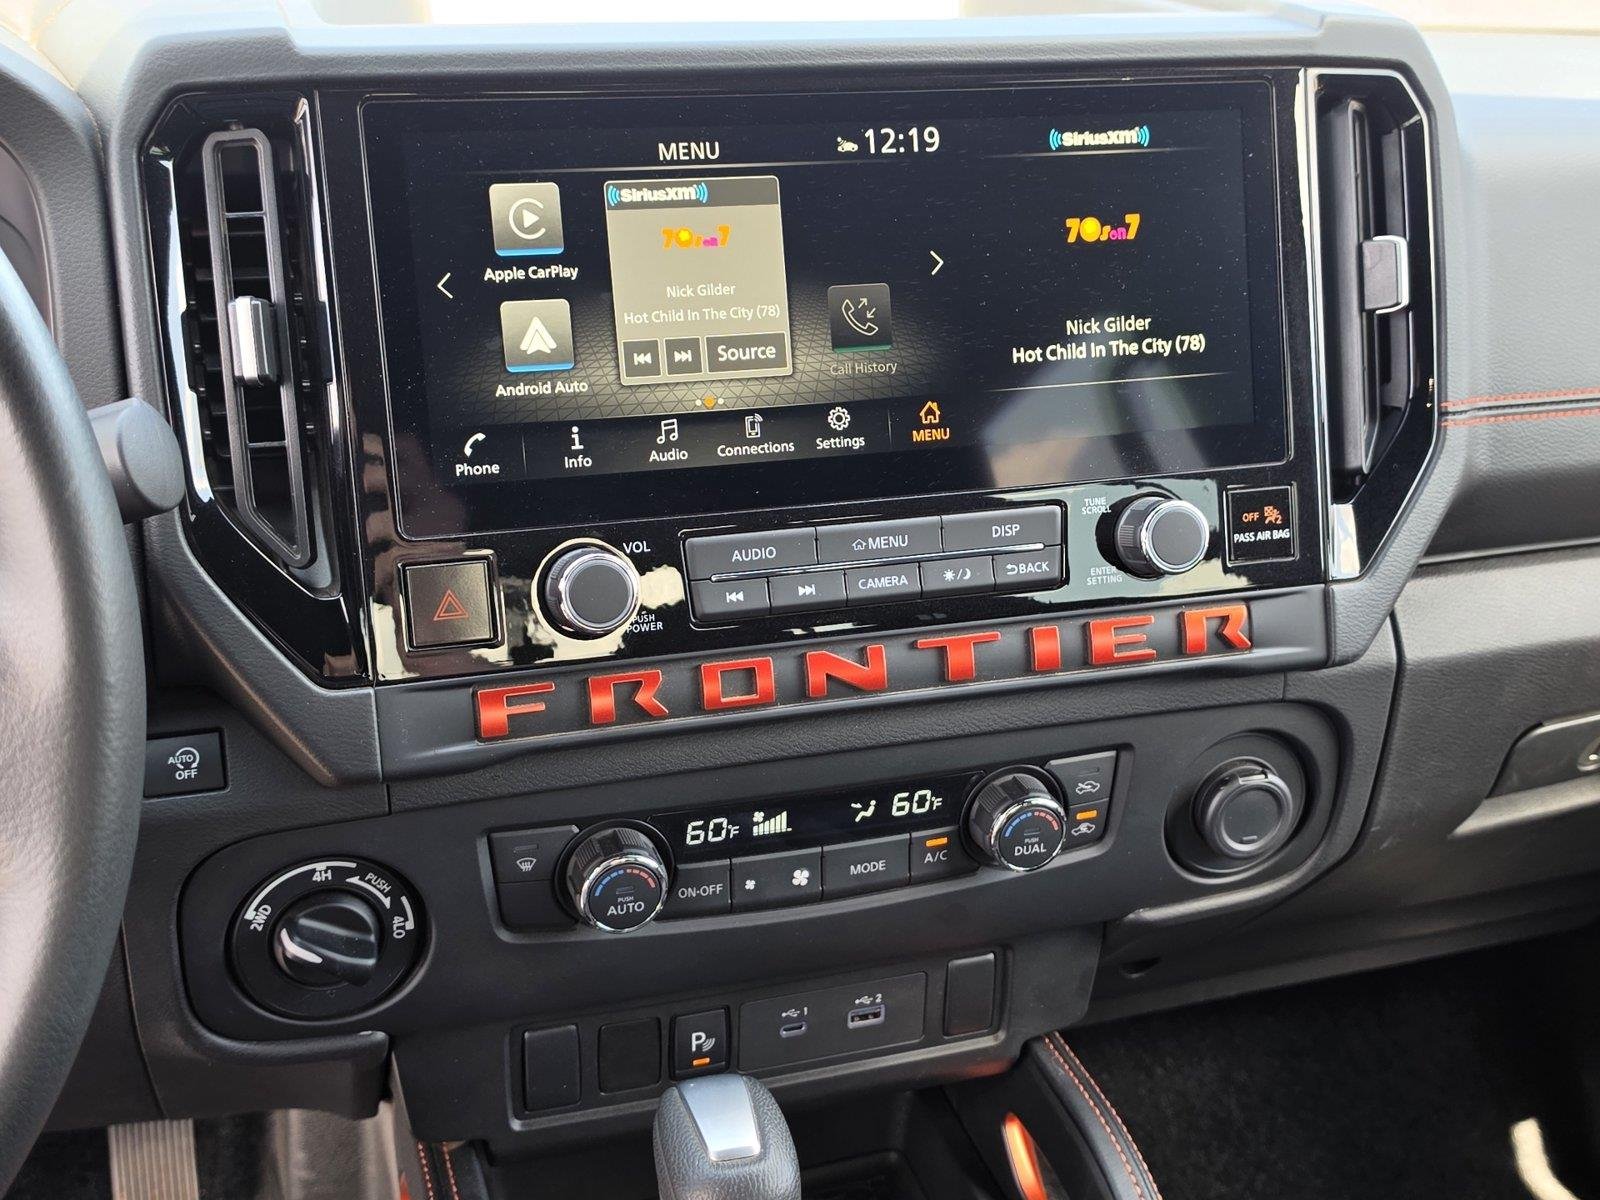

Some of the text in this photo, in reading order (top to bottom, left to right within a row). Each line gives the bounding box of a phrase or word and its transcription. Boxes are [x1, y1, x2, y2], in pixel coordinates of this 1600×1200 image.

[864, 126, 940, 154] 12:19
[658, 141, 721, 161] MENU
[484, 264, 579, 283] Apple CarPlay
[666, 283, 736, 298] Nick Gilder
[624, 304, 781, 324] Hot Child In The City (78)
[1065, 315, 1152, 335] Nick Gilder
[717, 344, 777, 362] Source
[1012, 333, 1206, 363] Hot Child In The City (78)
[830, 360, 898, 376] Call History
[495, 380, 589, 397] Android Auto
[912, 426, 950, 442] MENU
[717, 439, 795, 458] Connections
[816, 433, 866, 451] Settings
[564, 454, 592, 469] Info
[648, 448, 689, 463] Audio
[455, 461, 500, 477] Phone
[1083, 496, 1107, 506] TUNE
[1081, 504, 1112, 515] SCROLL
[1242, 511, 1259, 523] OFF
[992, 524, 1020, 538] DISP
[1233, 528, 1290, 543] PASS AIR BAG
[623, 541, 651, 554] VOL
[868, 535, 909, 550] MENU
[732, 547, 777, 562] AUDIO
[1019, 560, 1050, 573] BACK
[858, 575, 909, 590] CAMERA
[1087, 574, 1123, 585] SETTING
[627, 622, 663, 633] POWER
[475, 605, 1253, 739] FRONTIER
[167, 754, 194, 765] AUTO
[175, 768, 198, 780] OFF
[924, 850, 948, 864] A/C
[1014, 845, 1047, 856] DUAL
[850, 859, 887, 876] MODE
[312, 869, 332, 882] 4H
[364, 872, 392, 894] PUSH
[606, 901, 645, 916] AUTO
[250, 903, 272, 932] 2WD
[392, 915, 406, 939] 4LO
[875, 993, 883, 1003] 2
